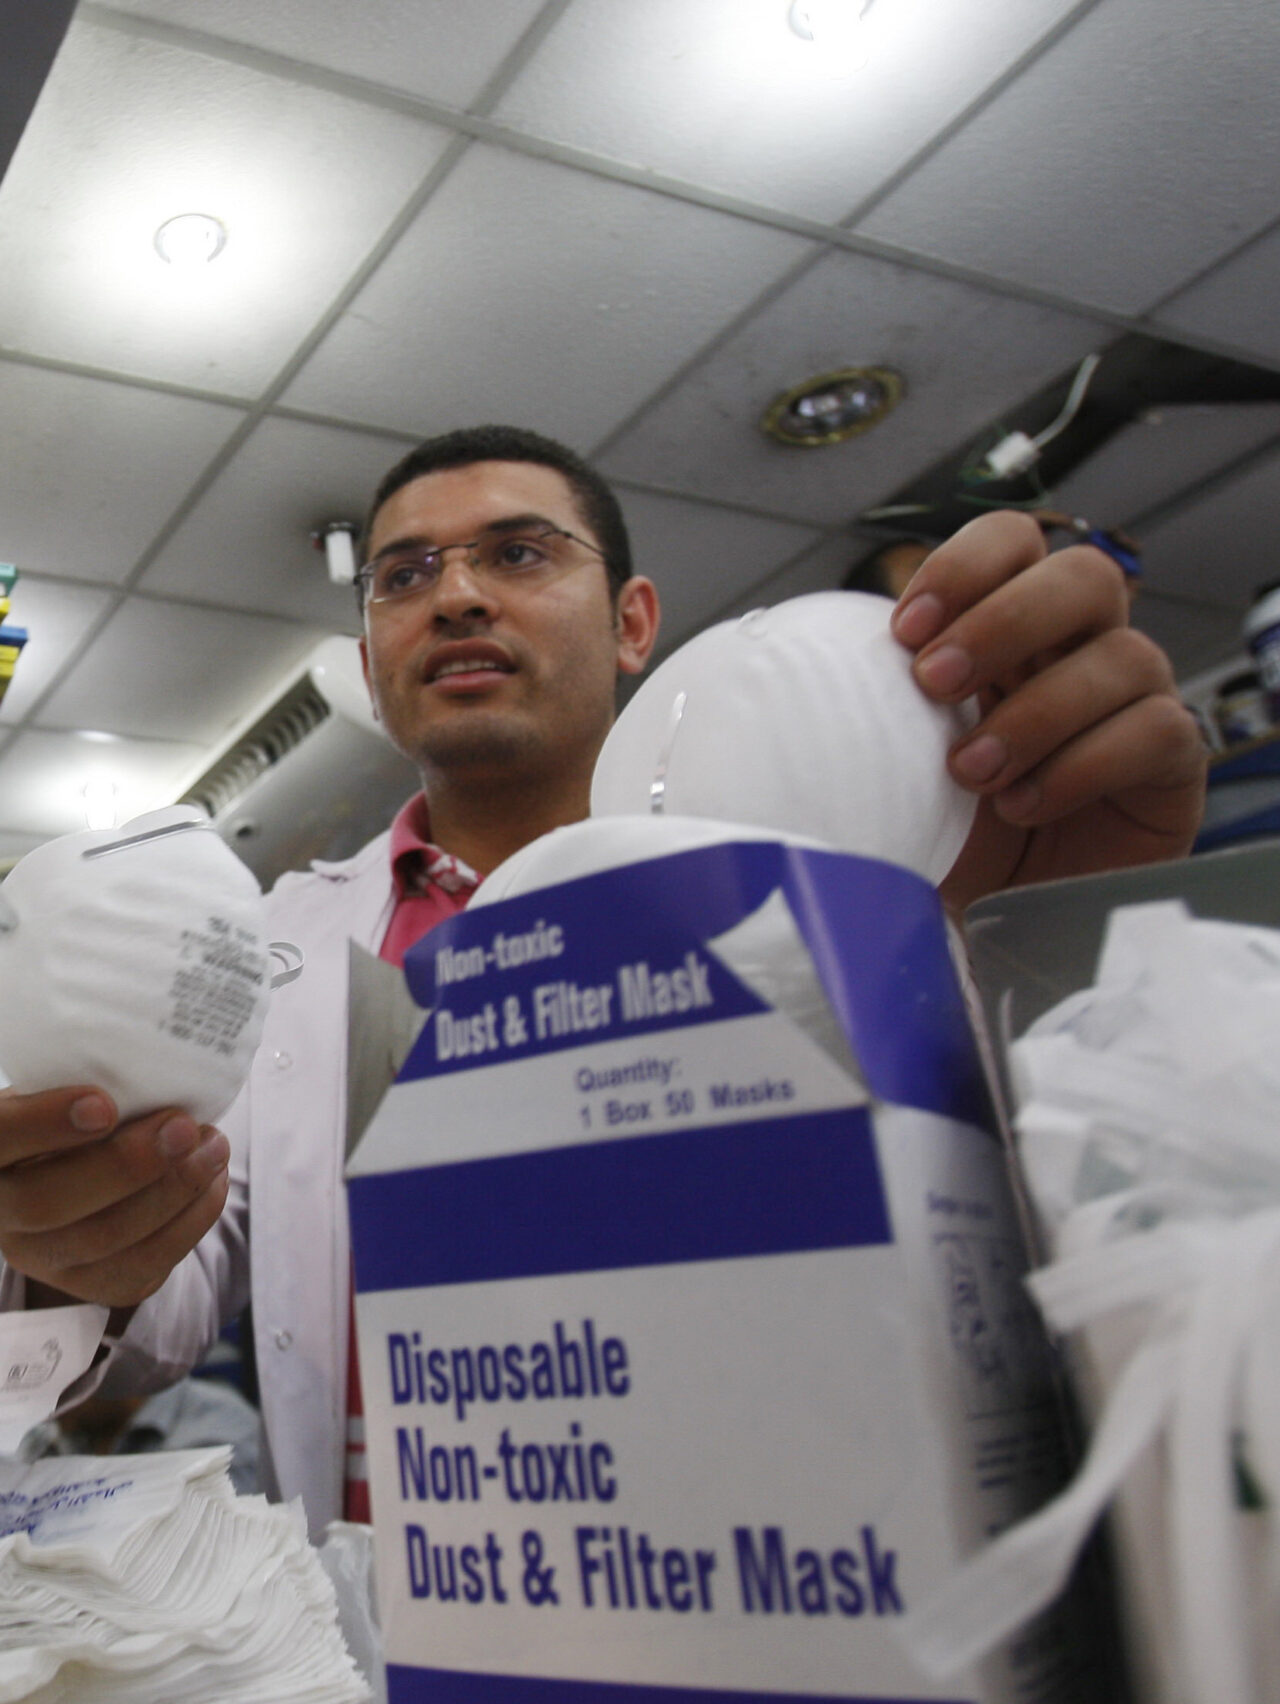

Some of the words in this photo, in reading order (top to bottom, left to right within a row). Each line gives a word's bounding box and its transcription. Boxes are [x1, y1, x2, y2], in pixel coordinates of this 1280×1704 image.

[435, 918, 565, 987] Non-toxic
[435, 1001, 499, 1062] Dust
[503, 996, 528, 1048] &
[533, 980, 613, 1040] Filter
[618, 951, 713, 1023] Mask
[576, 1057, 681, 1093] Quantity:
[580, 1105, 592, 1128] 1
[604, 1098, 652, 1126] Box
[665, 1089, 695, 1117] 50
[709, 1077, 796, 1110] Masks
[388, 1318, 632, 1422] Disposable
[395, 1421, 618, 1503] Non-toxic
[405, 1523, 508, 1604] Dust
[519, 1528, 561, 1607] &
[574, 1526, 717, 1613] Filter
[732, 1525, 906, 1618] Mask
